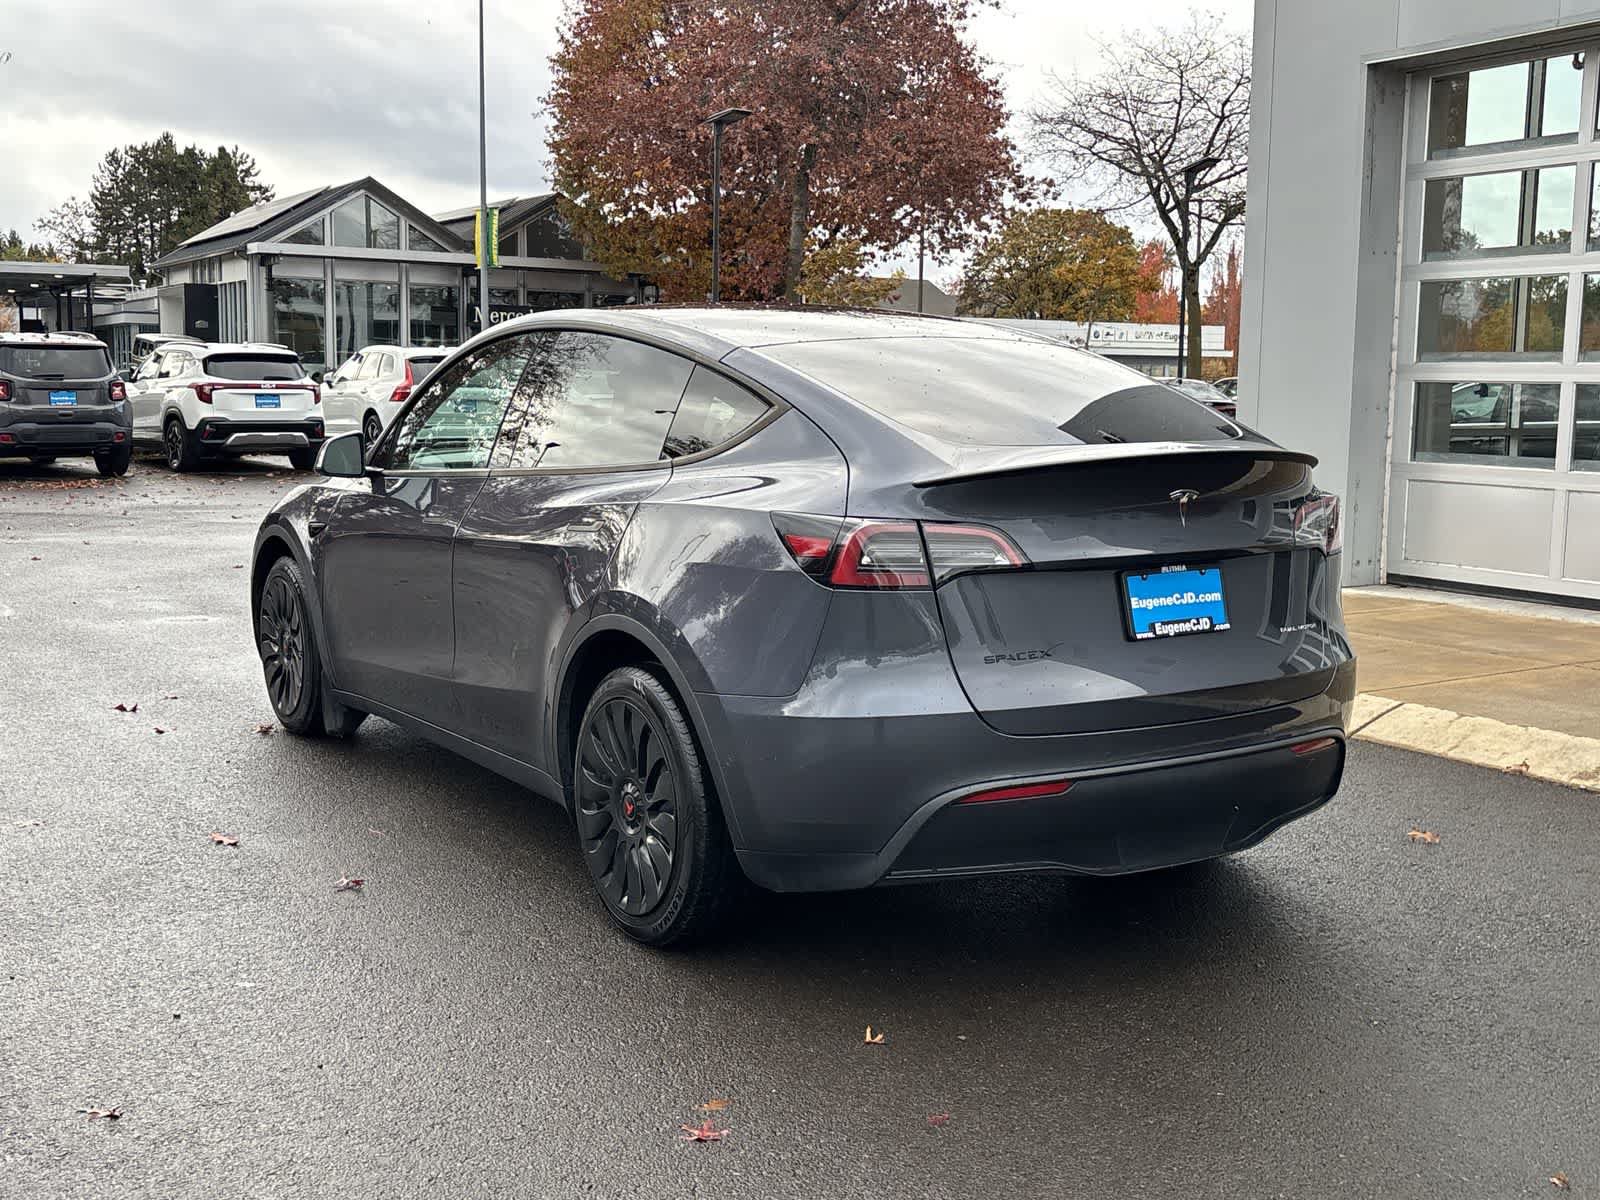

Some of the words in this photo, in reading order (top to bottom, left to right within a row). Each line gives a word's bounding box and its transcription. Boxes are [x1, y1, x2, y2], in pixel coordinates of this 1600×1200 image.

[1130, 592, 1221, 609] EugeneCJD.com
[1155, 618, 1210, 635] EugeneCJD
[983, 642, 1064, 664] SPACEX
